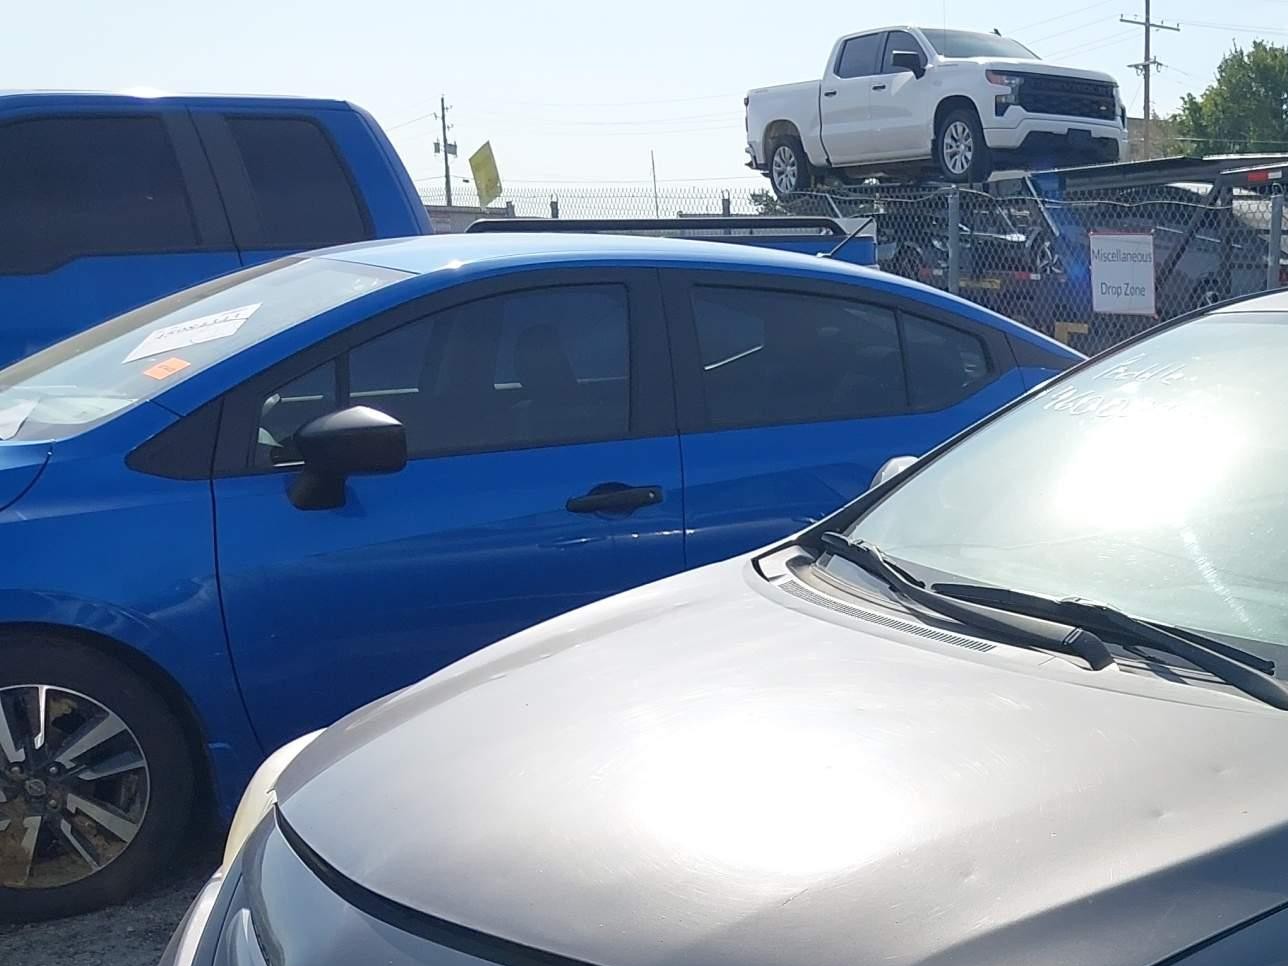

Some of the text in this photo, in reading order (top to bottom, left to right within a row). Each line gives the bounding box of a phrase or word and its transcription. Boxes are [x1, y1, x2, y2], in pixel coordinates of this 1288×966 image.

[1092, 248, 1152, 263] Miscellaneous
[1100, 282, 1146, 298] Drop Zone
